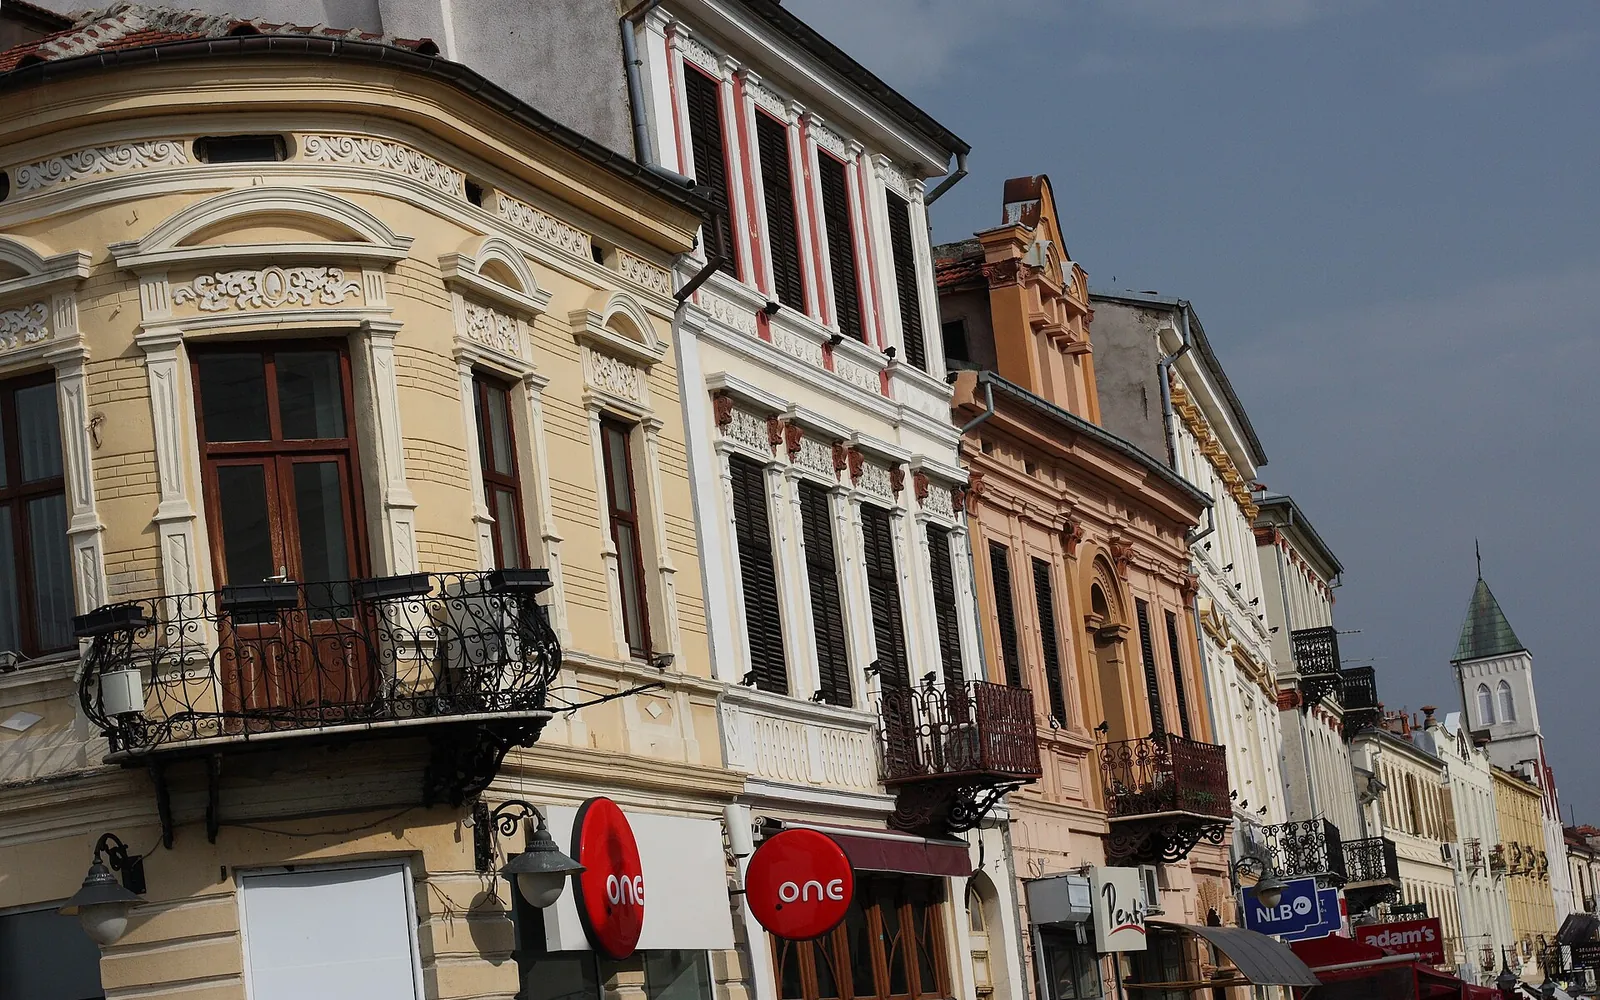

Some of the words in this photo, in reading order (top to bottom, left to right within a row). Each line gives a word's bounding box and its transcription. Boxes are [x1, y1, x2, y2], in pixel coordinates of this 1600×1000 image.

[1101, 881, 1145, 930] Penti
[1256, 904, 1293, 923] NLB
[1365, 926, 1435, 947] adam's
